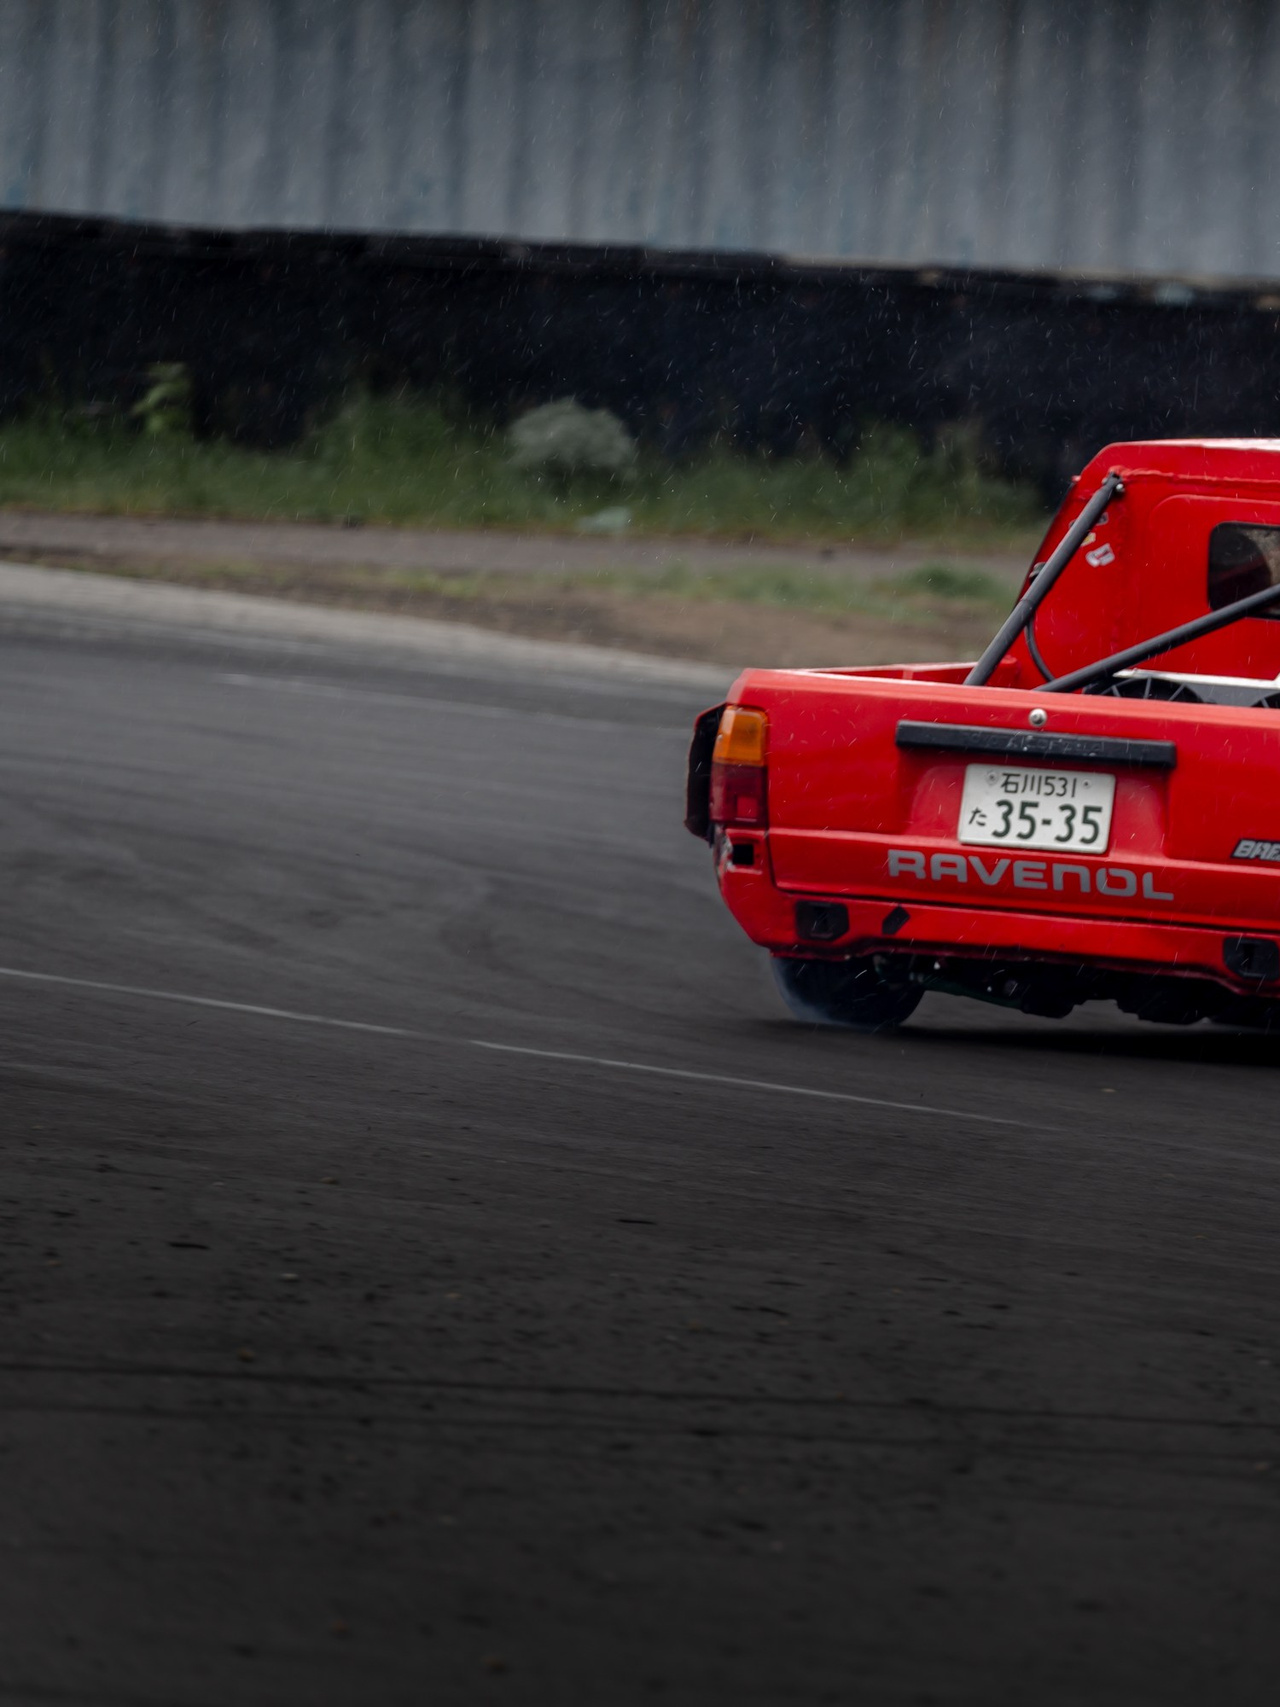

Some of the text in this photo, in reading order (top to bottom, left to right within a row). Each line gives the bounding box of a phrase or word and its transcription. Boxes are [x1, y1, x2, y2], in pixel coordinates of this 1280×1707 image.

[1001, 772, 1078, 798] 石川531
[968, 799, 1103, 845] た 35-35
[888, 848, 1175, 902] RAVENOL
